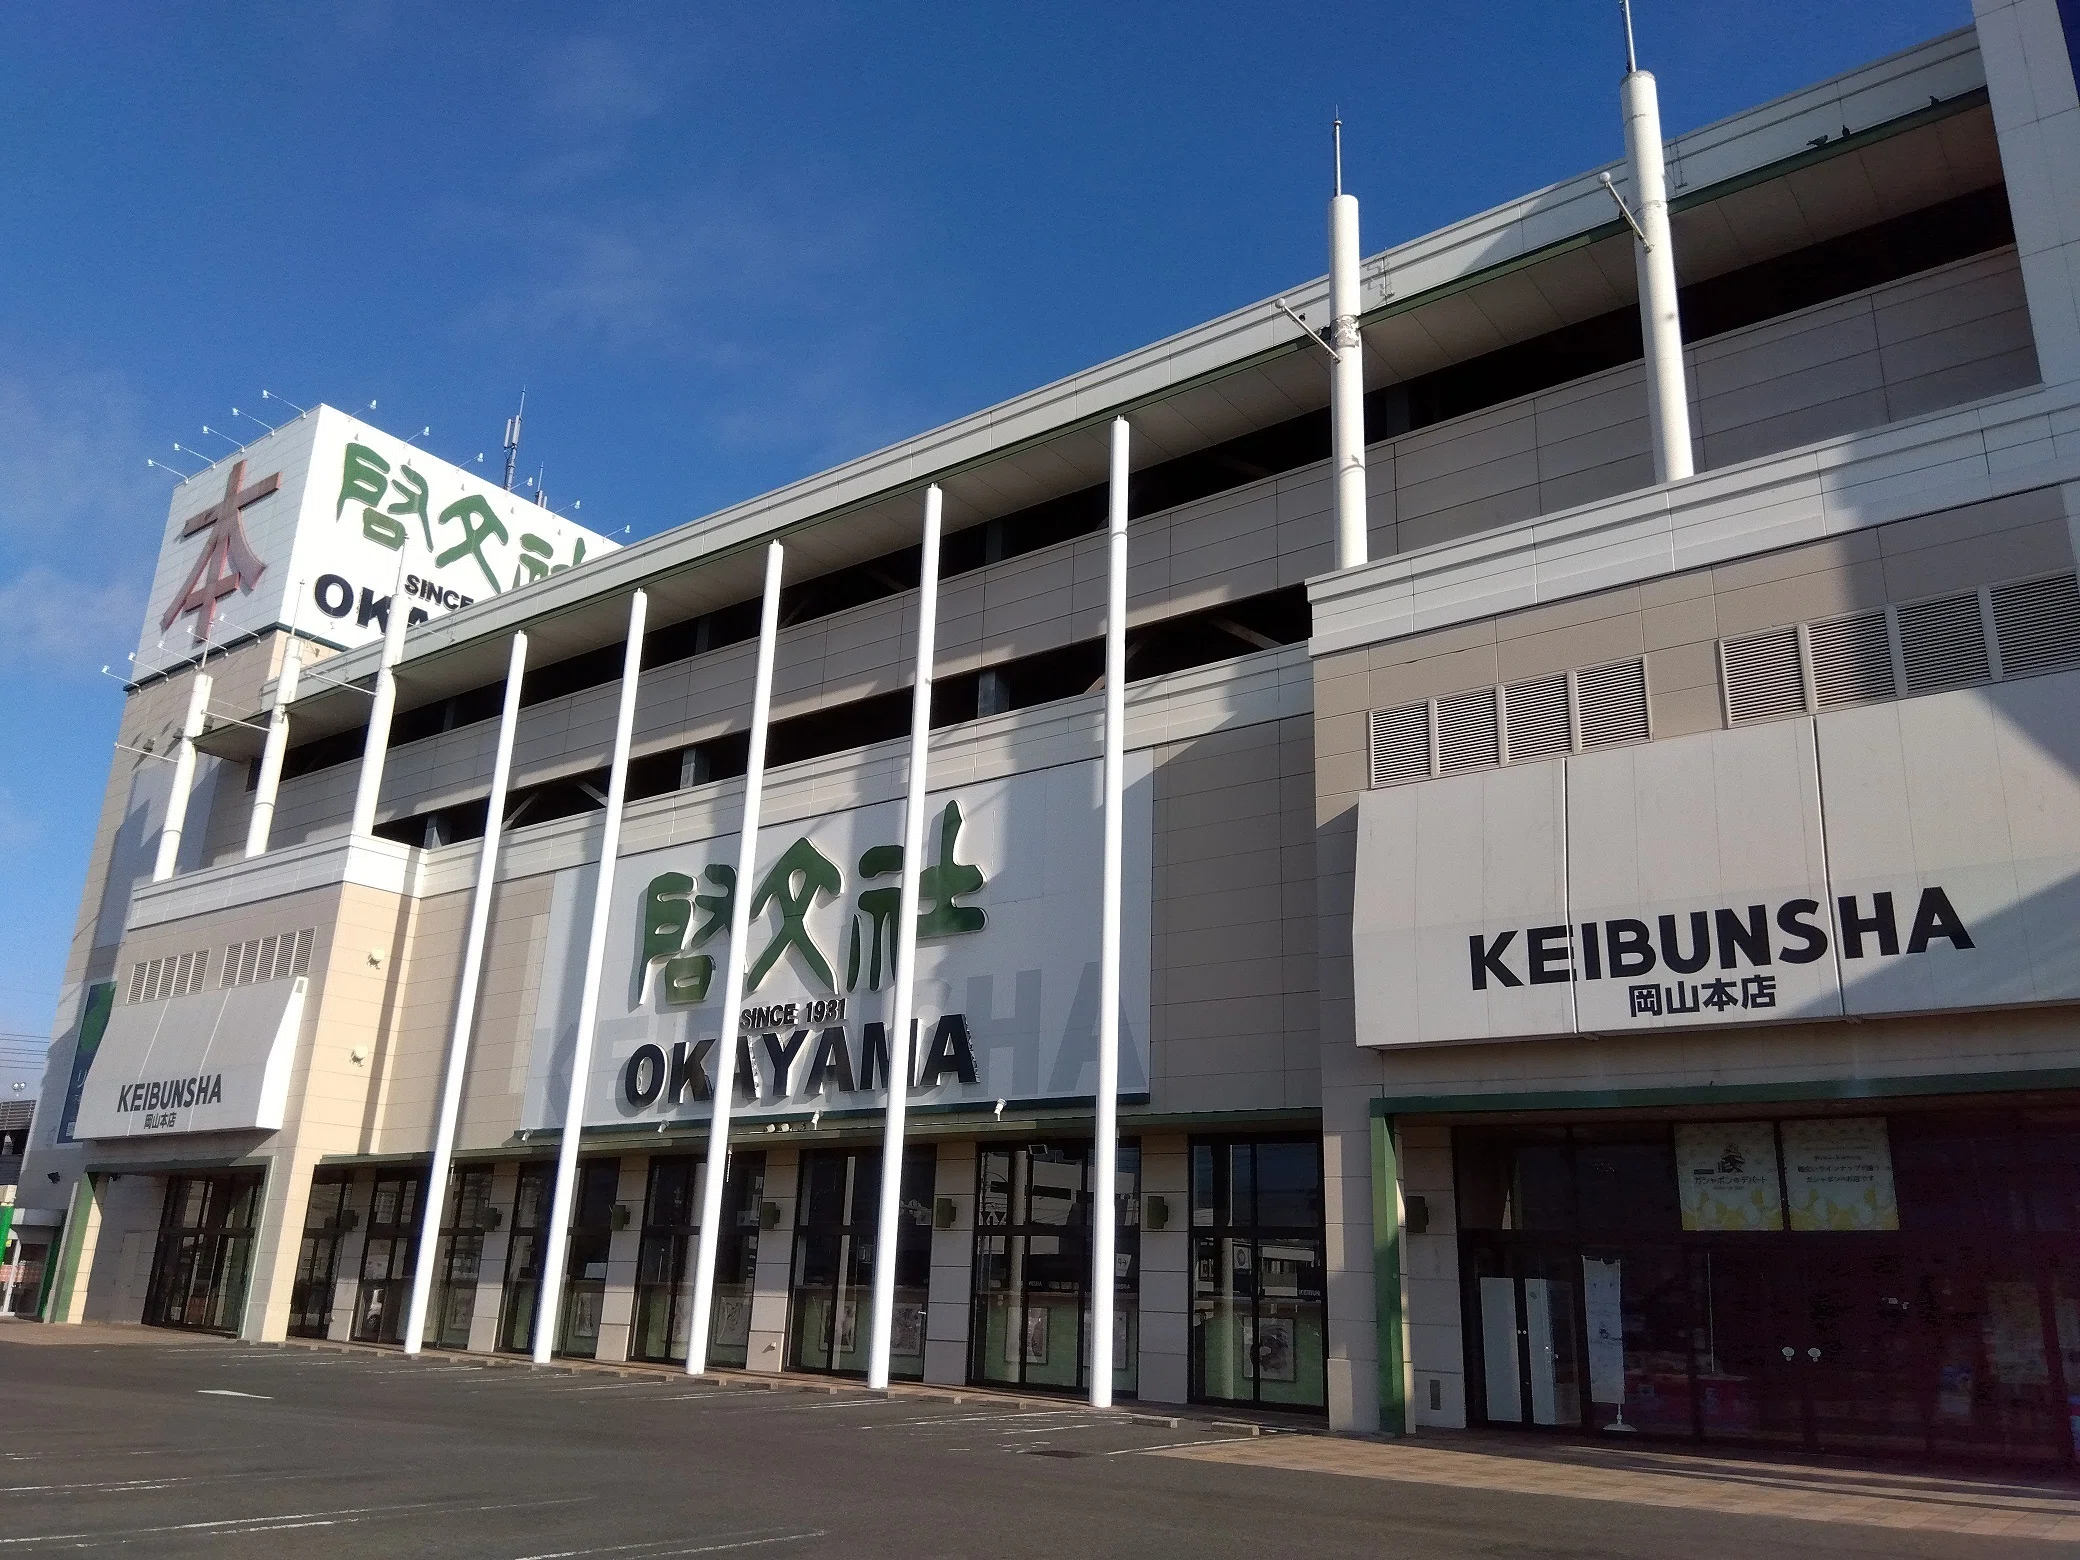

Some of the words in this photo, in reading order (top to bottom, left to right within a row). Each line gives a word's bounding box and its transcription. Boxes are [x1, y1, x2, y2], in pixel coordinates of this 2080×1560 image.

[1470, 886, 1976, 990] KEIBUNSHA
[740, 1003, 797, 1029] SINCE
[805, 998, 847, 1023] 1931
[1628, 975, 1777, 1017] 岡山本店
[625, 1013, 981, 1108] OKAYAMA
[117, 1074, 222, 1113] KEIBUNSHA
[144, 1112, 177, 1129] 岡山本店
